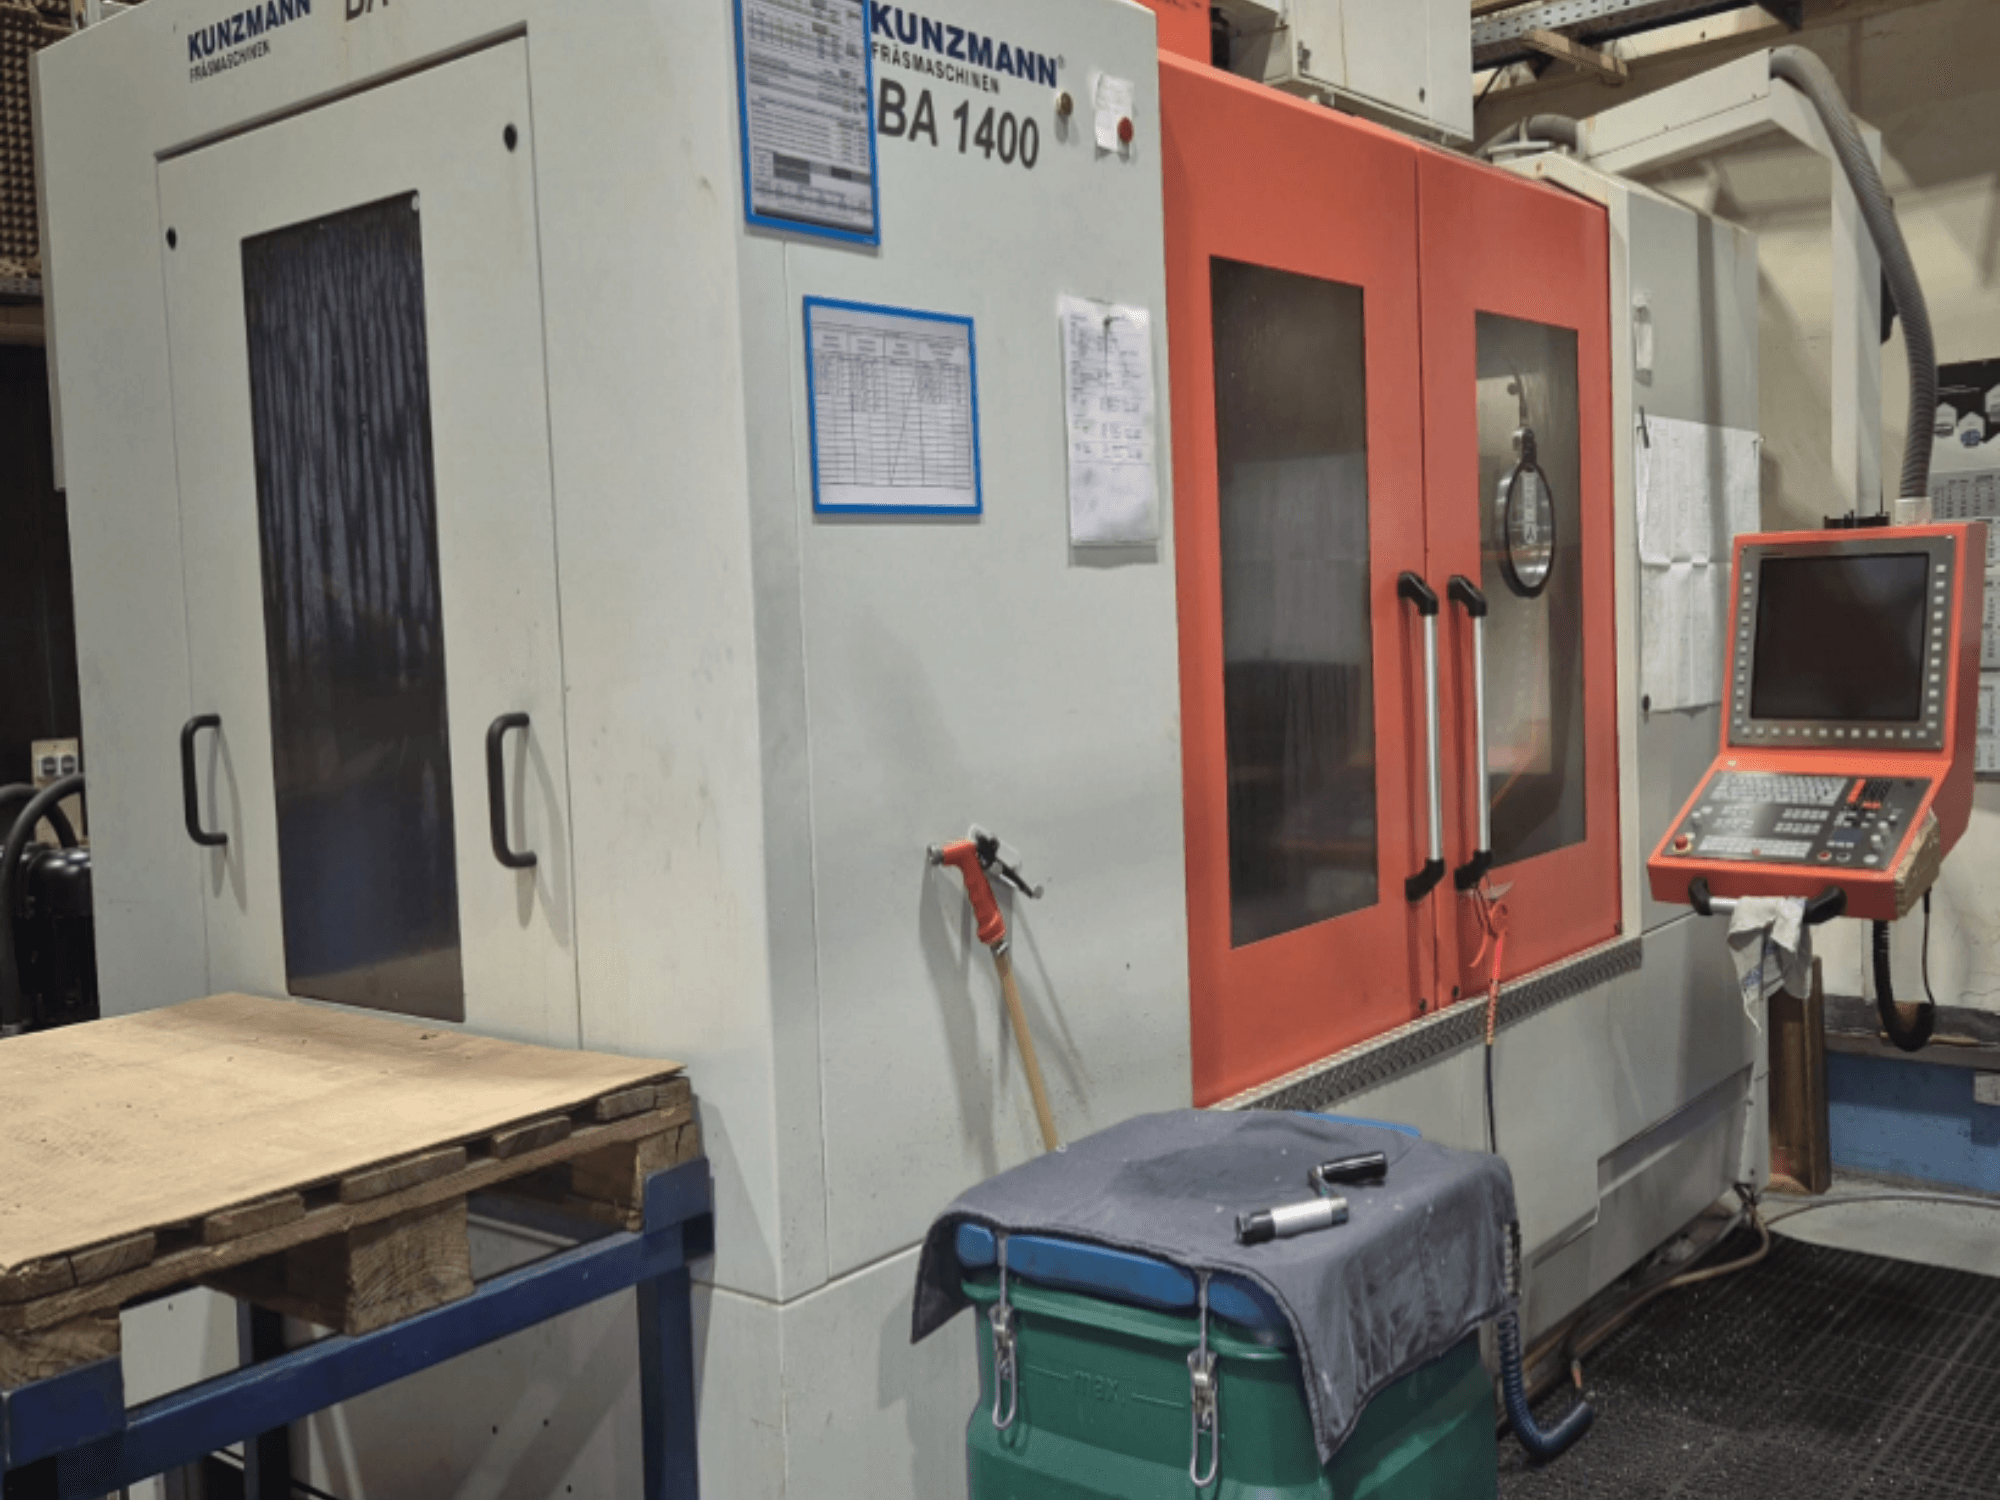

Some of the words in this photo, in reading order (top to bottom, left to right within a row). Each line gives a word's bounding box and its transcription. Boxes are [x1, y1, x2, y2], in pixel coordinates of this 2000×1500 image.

[187, 0, 311, 62] KUNZMANN
[871, 41, 1000, 95] FRÄSMASCHINEN
[878, 77, 938, 147] BA
[953, 99, 1040, 169] 1400
